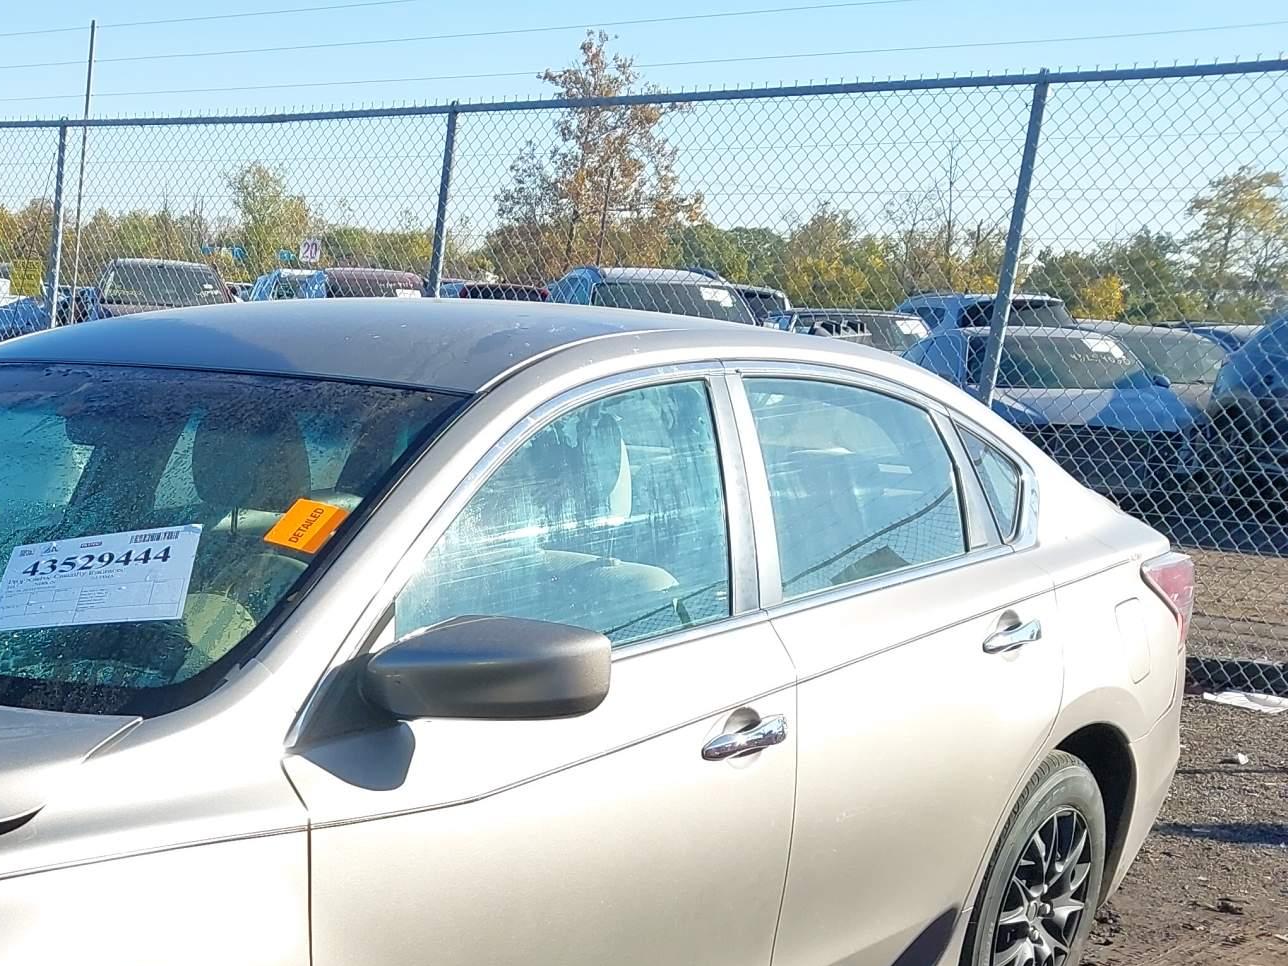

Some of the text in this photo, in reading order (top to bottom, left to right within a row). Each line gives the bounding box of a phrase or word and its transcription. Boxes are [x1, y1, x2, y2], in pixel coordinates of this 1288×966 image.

[301, 240, 318, 259] 20
[288, 507, 325, 543] DETAILED
[22, 546, 171, 577] 43529444
